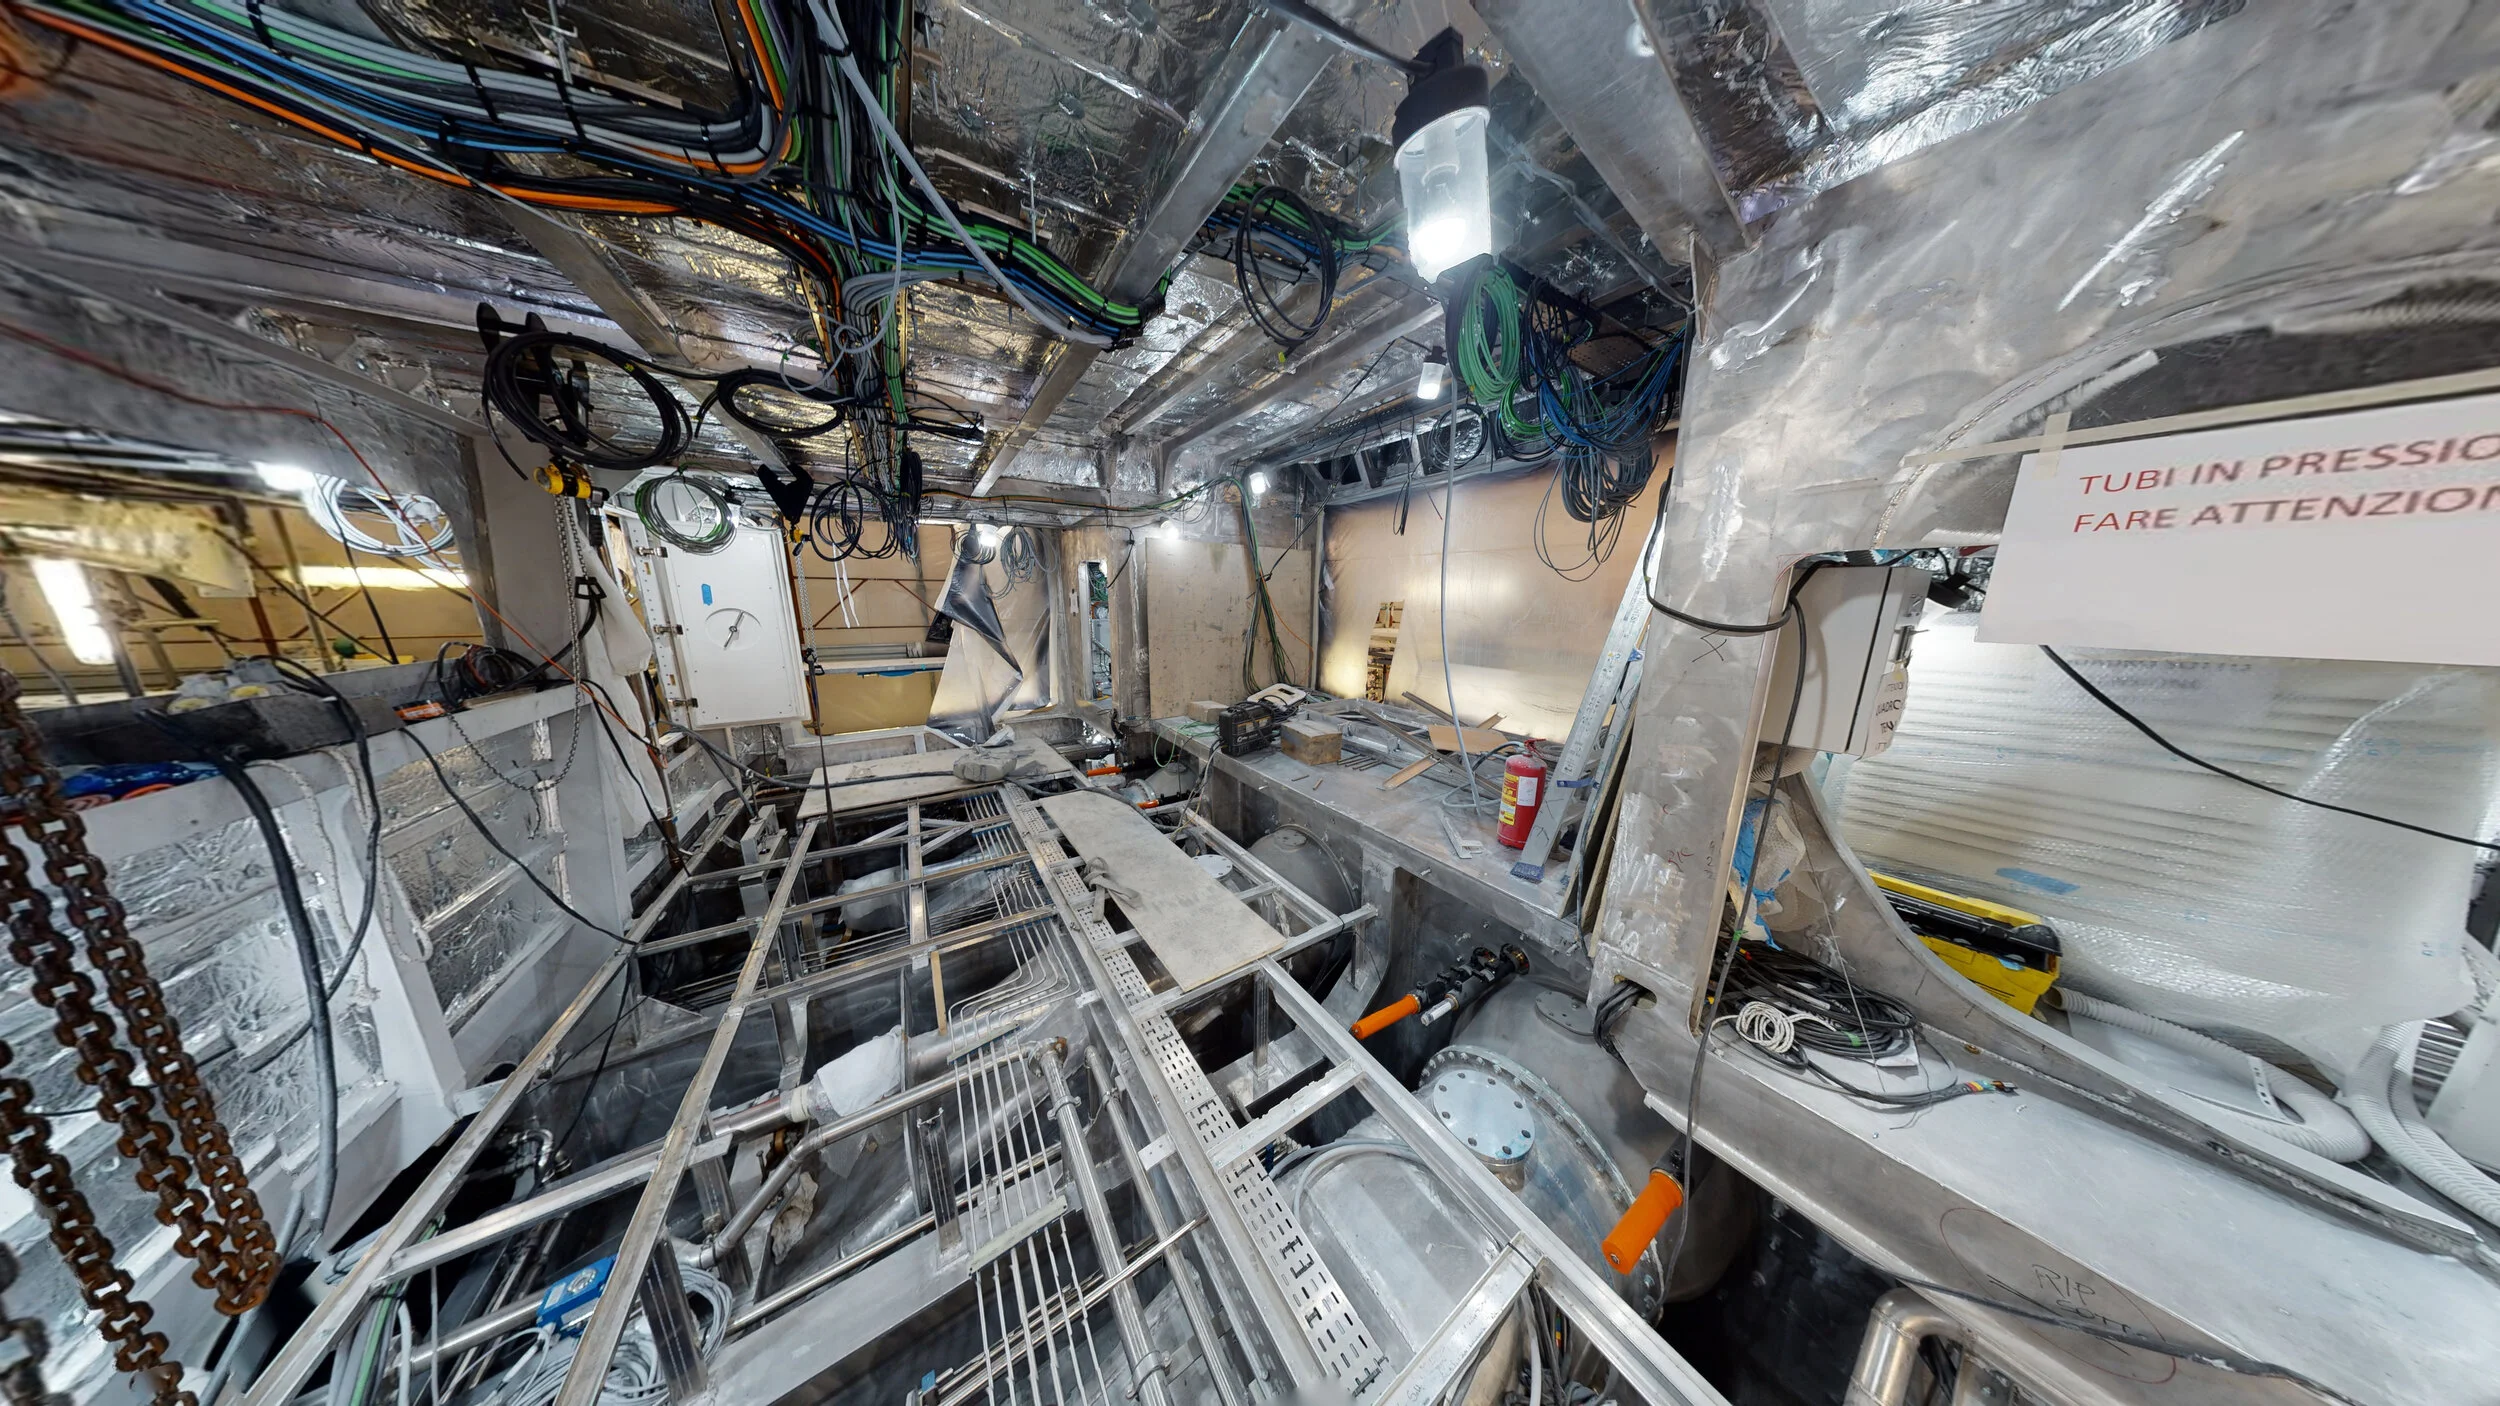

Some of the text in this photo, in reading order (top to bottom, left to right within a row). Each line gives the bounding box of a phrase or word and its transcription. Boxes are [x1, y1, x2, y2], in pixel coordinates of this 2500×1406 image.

[2080, 432, 2500, 494] TUBI IN PRESSIO
[2072, 507, 2179, 533] FARE
[2031, 1264, 2095, 1305] RIP
[2055, 1299, 2148, 1337] SOTT
